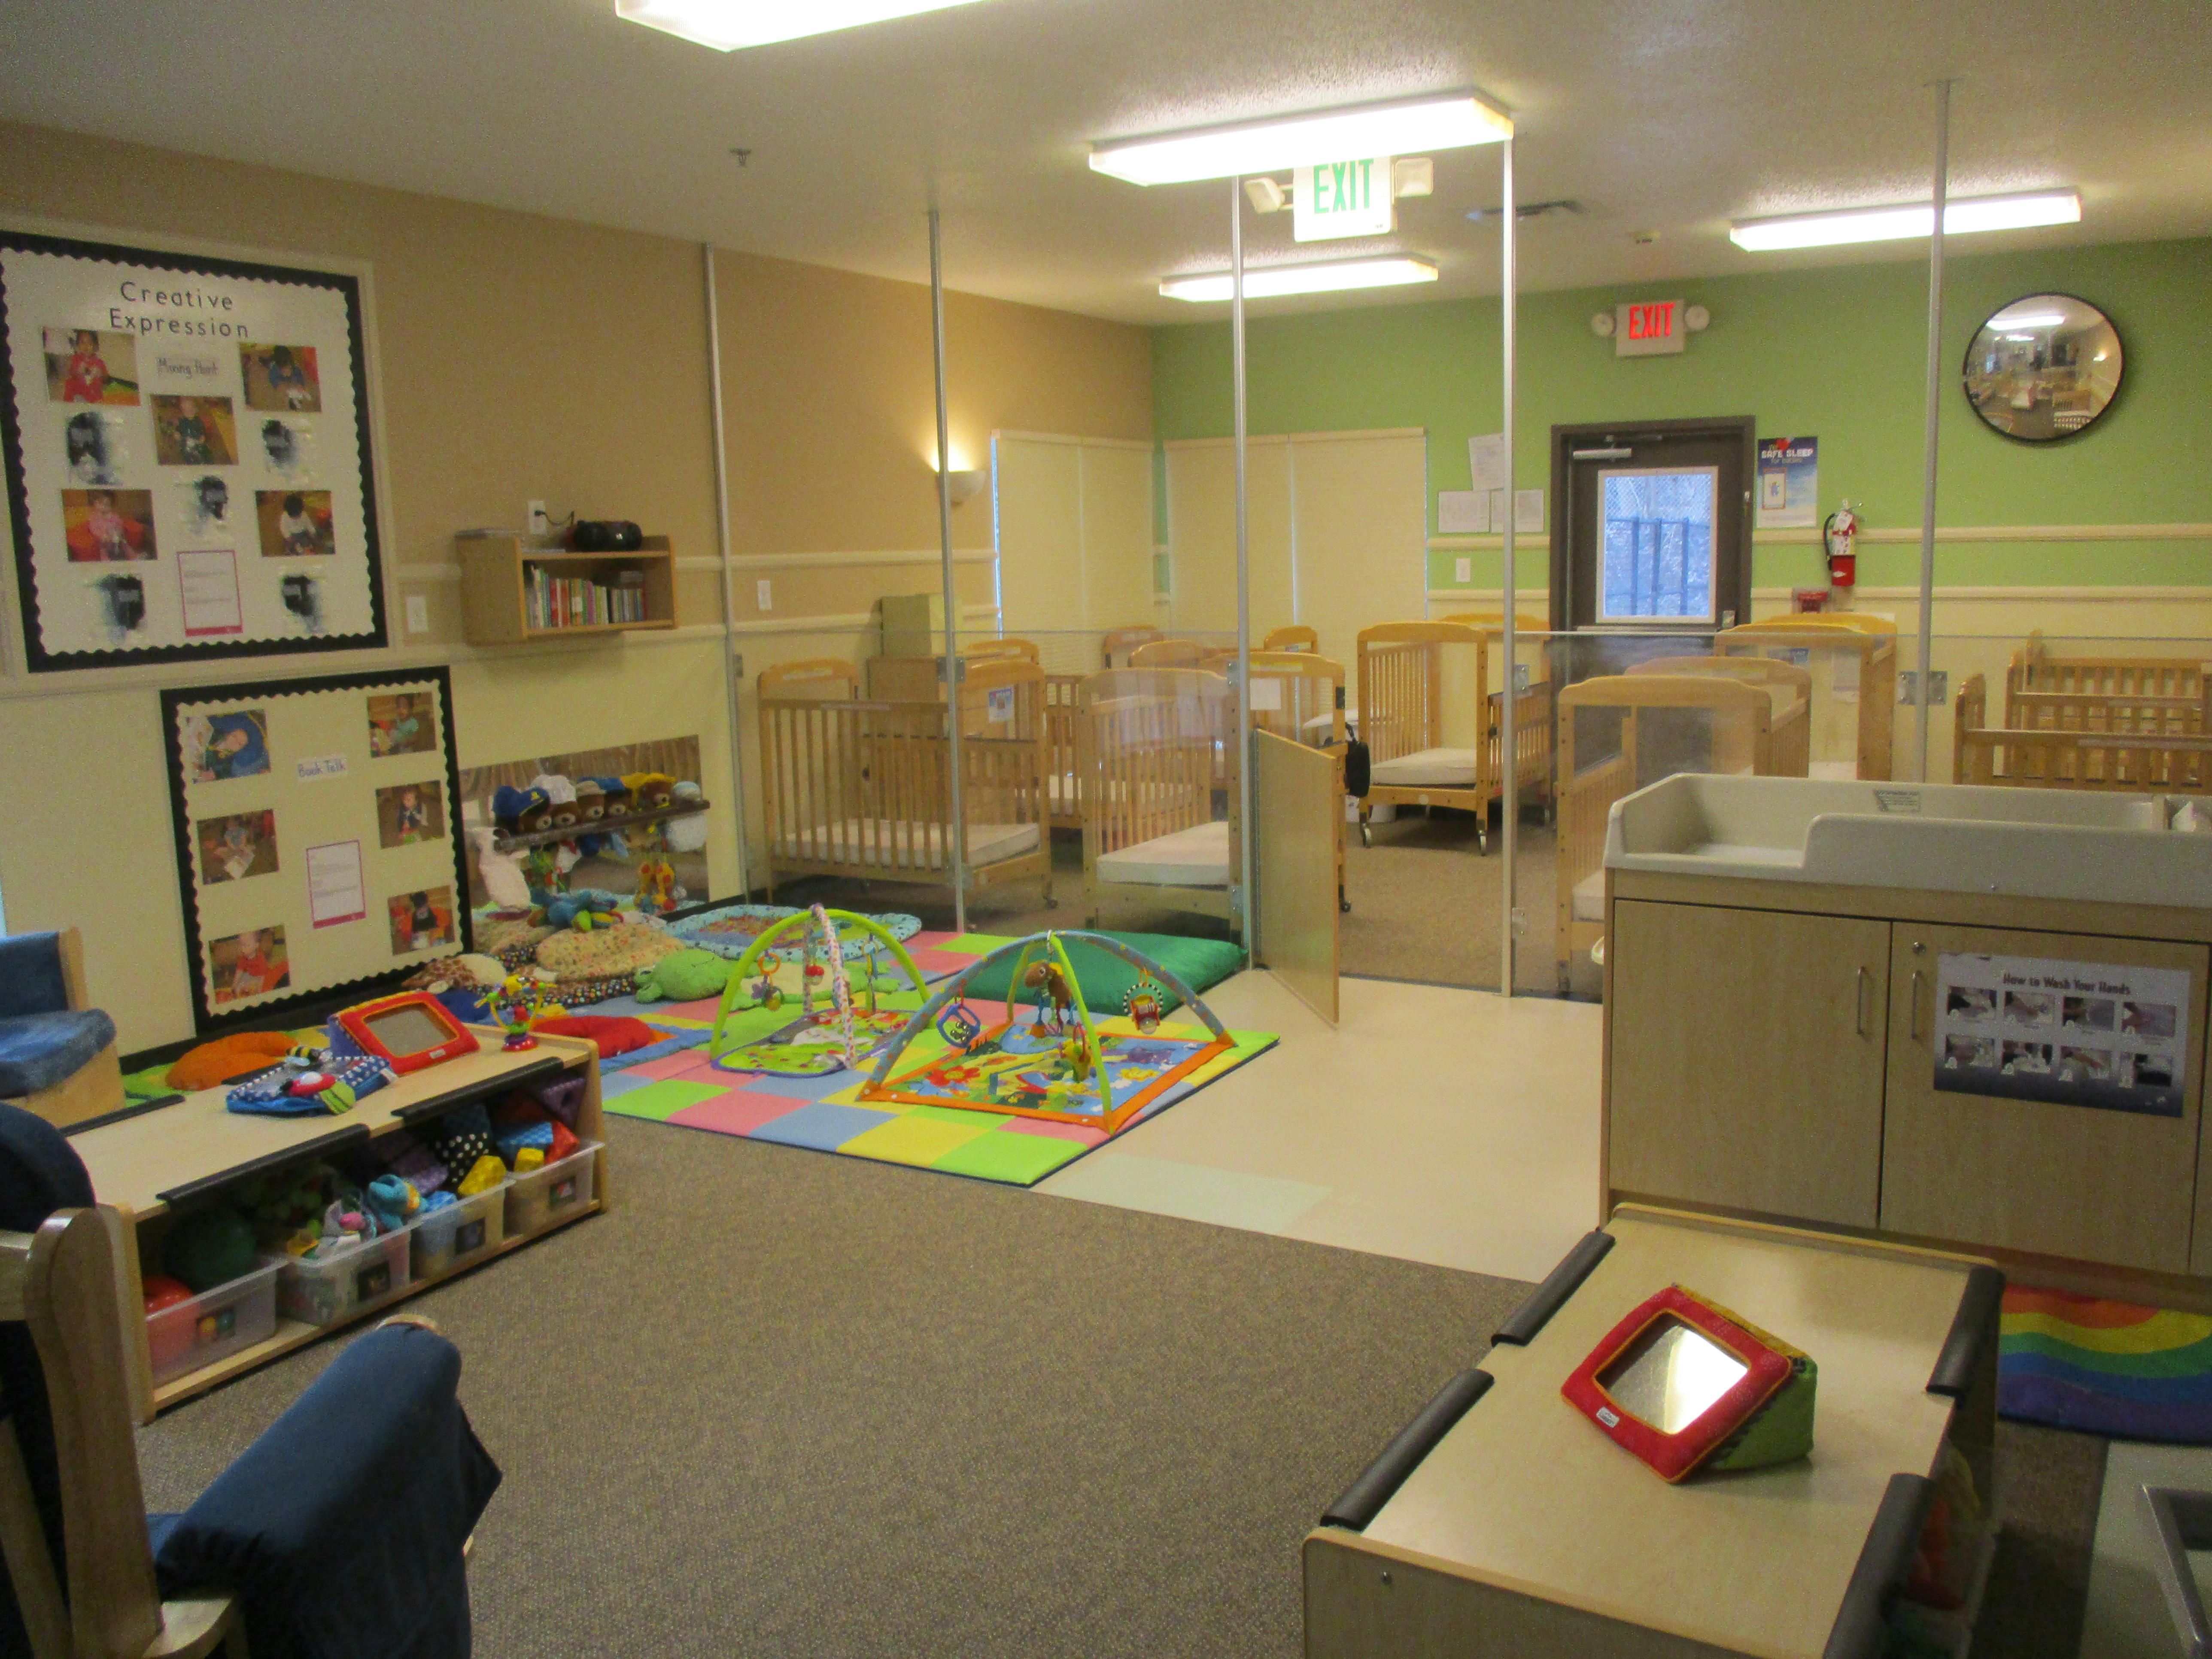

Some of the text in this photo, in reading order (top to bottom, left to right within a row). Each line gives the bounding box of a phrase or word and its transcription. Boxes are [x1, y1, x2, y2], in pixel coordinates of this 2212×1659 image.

[1313, 158, 1374, 214] EXIT
[121, 281, 233, 310] Creative
[110, 307, 249, 337] Expression
[1629, 302, 1675, 340] EXIT
[1786, 448, 1814, 457] SLEEP
[2003, 972, 2131, 995] How to Wash Your Hands
